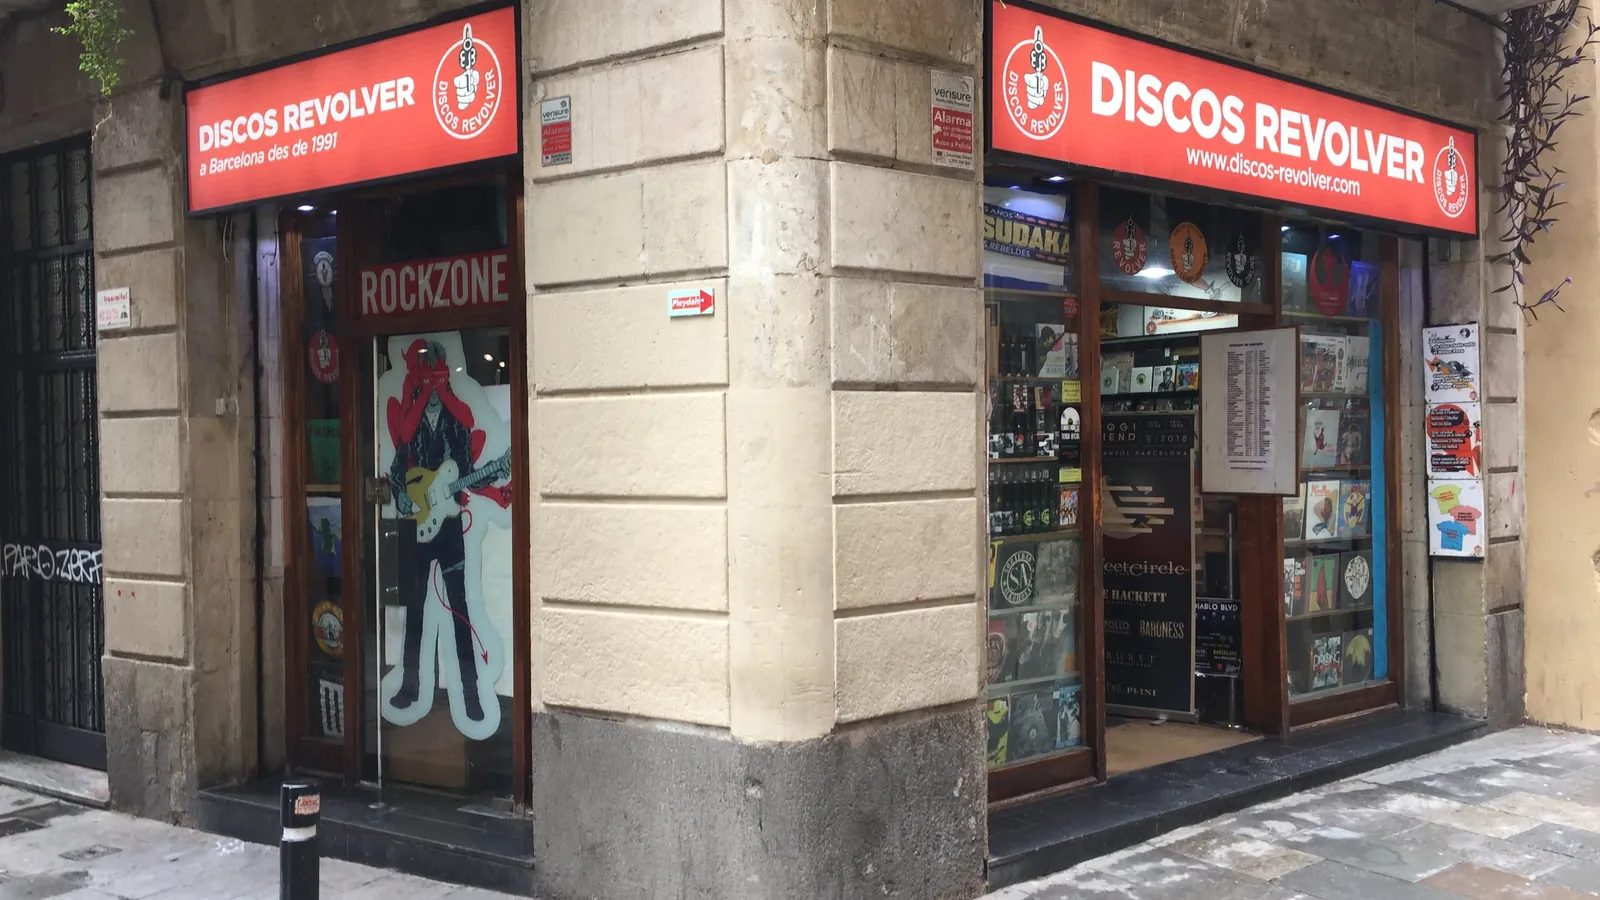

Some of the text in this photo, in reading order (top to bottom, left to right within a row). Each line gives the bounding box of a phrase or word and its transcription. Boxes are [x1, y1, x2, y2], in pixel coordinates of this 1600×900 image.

[199, 76, 415, 152] DISCOS REVOLVER
[437, 68, 496, 132] DISCOS REVOLVER
[934, 110, 971, 127] Alarma
[1008, 70, 1064, 134] DISCOS REVOLVER
[1091, 60, 1425, 184] DISCOS REVOLVER
[199, 131, 338, 177] a Barcelona des de 1991
[1186, 147, 1361, 197] www.discos-revolver.com
[1436, 168, 1466, 214] DISCOS REVOLVER
[989, 241, 1031, 258] REBELDES
[1112, 240, 1147, 275] REVOLVER
[1225, 251, 1244, 287] REVOLVER
[361, 254, 509, 315] ROCKZONE
[1111, 589, 1168, 603] HACKETT
[1220, 603, 1238, 612] BLVD
[1139, 619, 1185, 639] BARONESS
